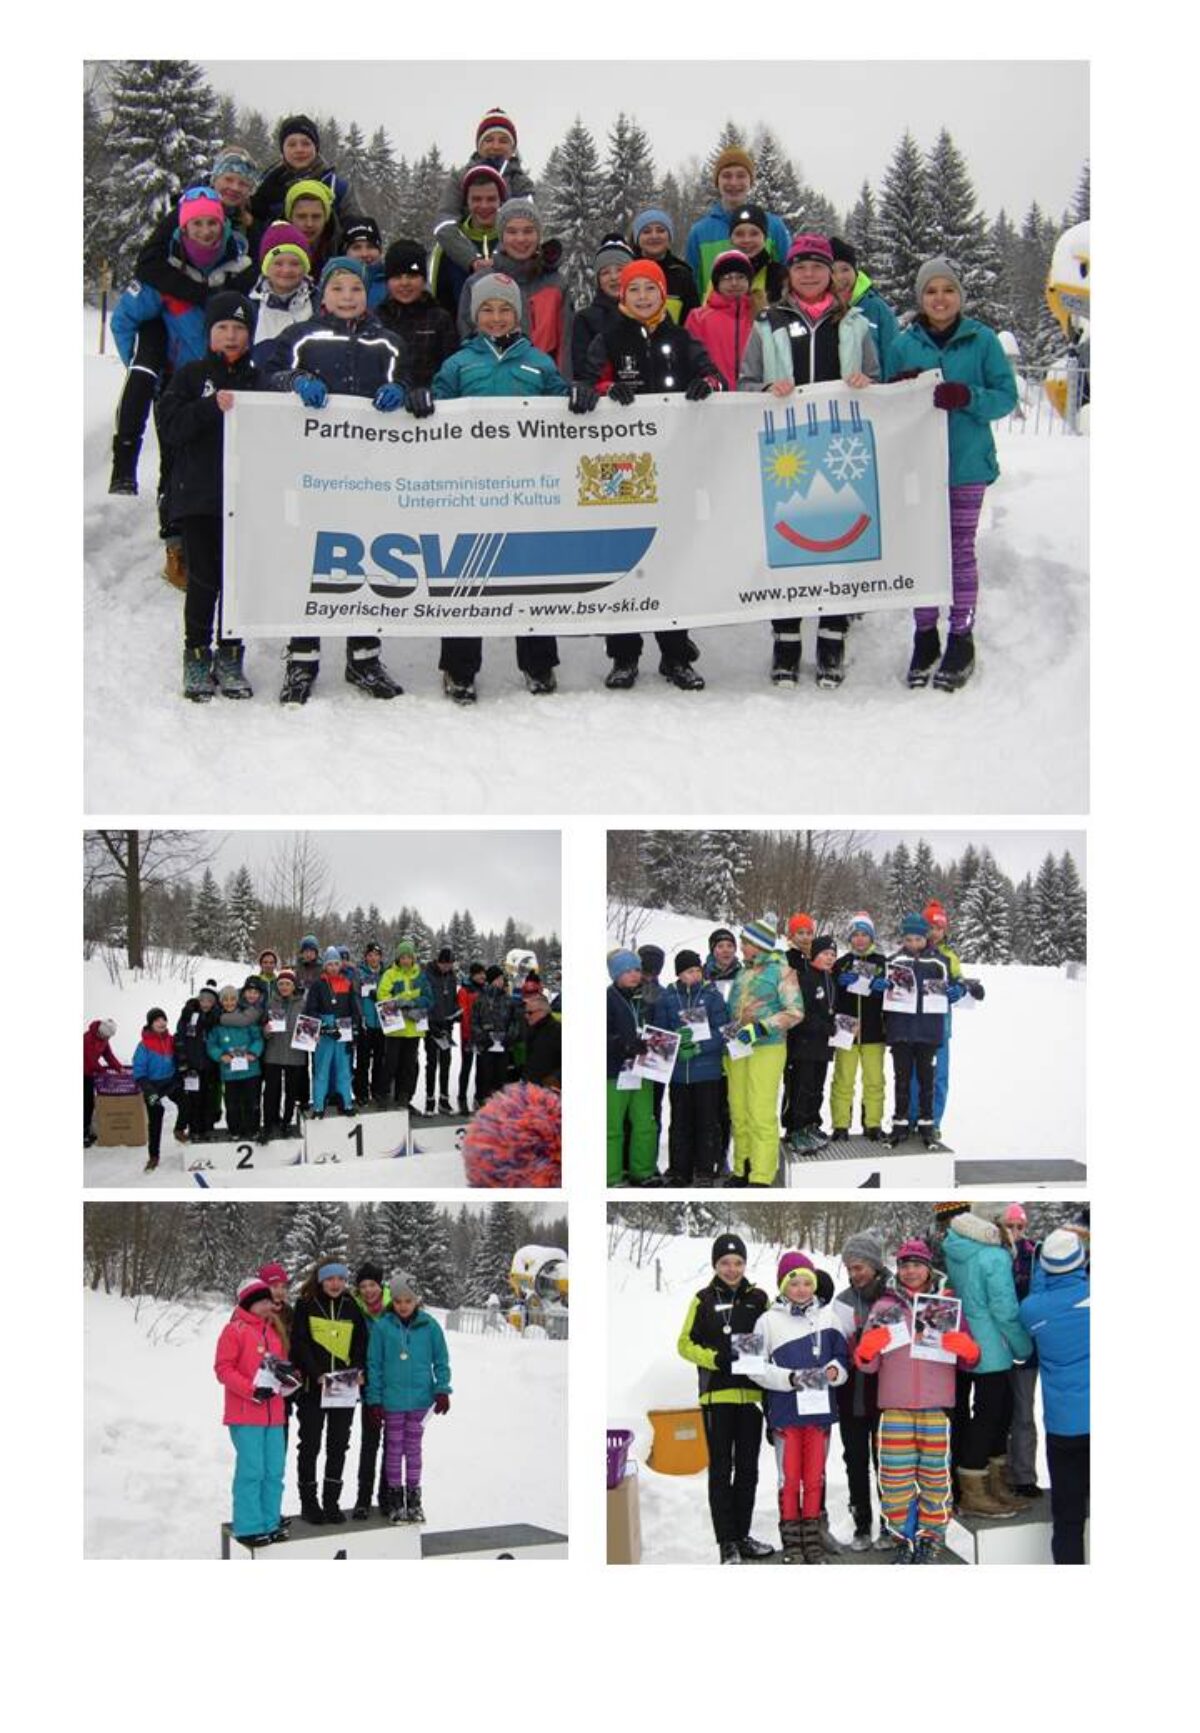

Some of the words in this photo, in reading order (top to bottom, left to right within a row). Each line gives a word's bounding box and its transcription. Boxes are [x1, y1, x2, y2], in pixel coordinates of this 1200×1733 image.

[304, 418, 463, 443] Partnerschule
[471, 420, 511, 439] des
[517, 419, 658, 442] Wintersports
[302, 474, 391, 492] Bayerisches
[396, 475, 536, 492] Staatsministerium
[540, 474, 561, 488] für
[398, 493, 475, 508] Unterricht
[479, 493, 509, 508] und
[514, 491, 561, 506] Kultus
[310, 531, 480, 599] BSV
[738, 575, 915, 604] www.pzw-bayern.de
[304, 600, 408, 619] Bayerischer
[413, 602, 514, 618] Skiverband
[529, 597, 660, 616] www.bsv-ski.de
[347, 1123, 364, 1157] 1
[236, 1144, 255, 1170] 2
